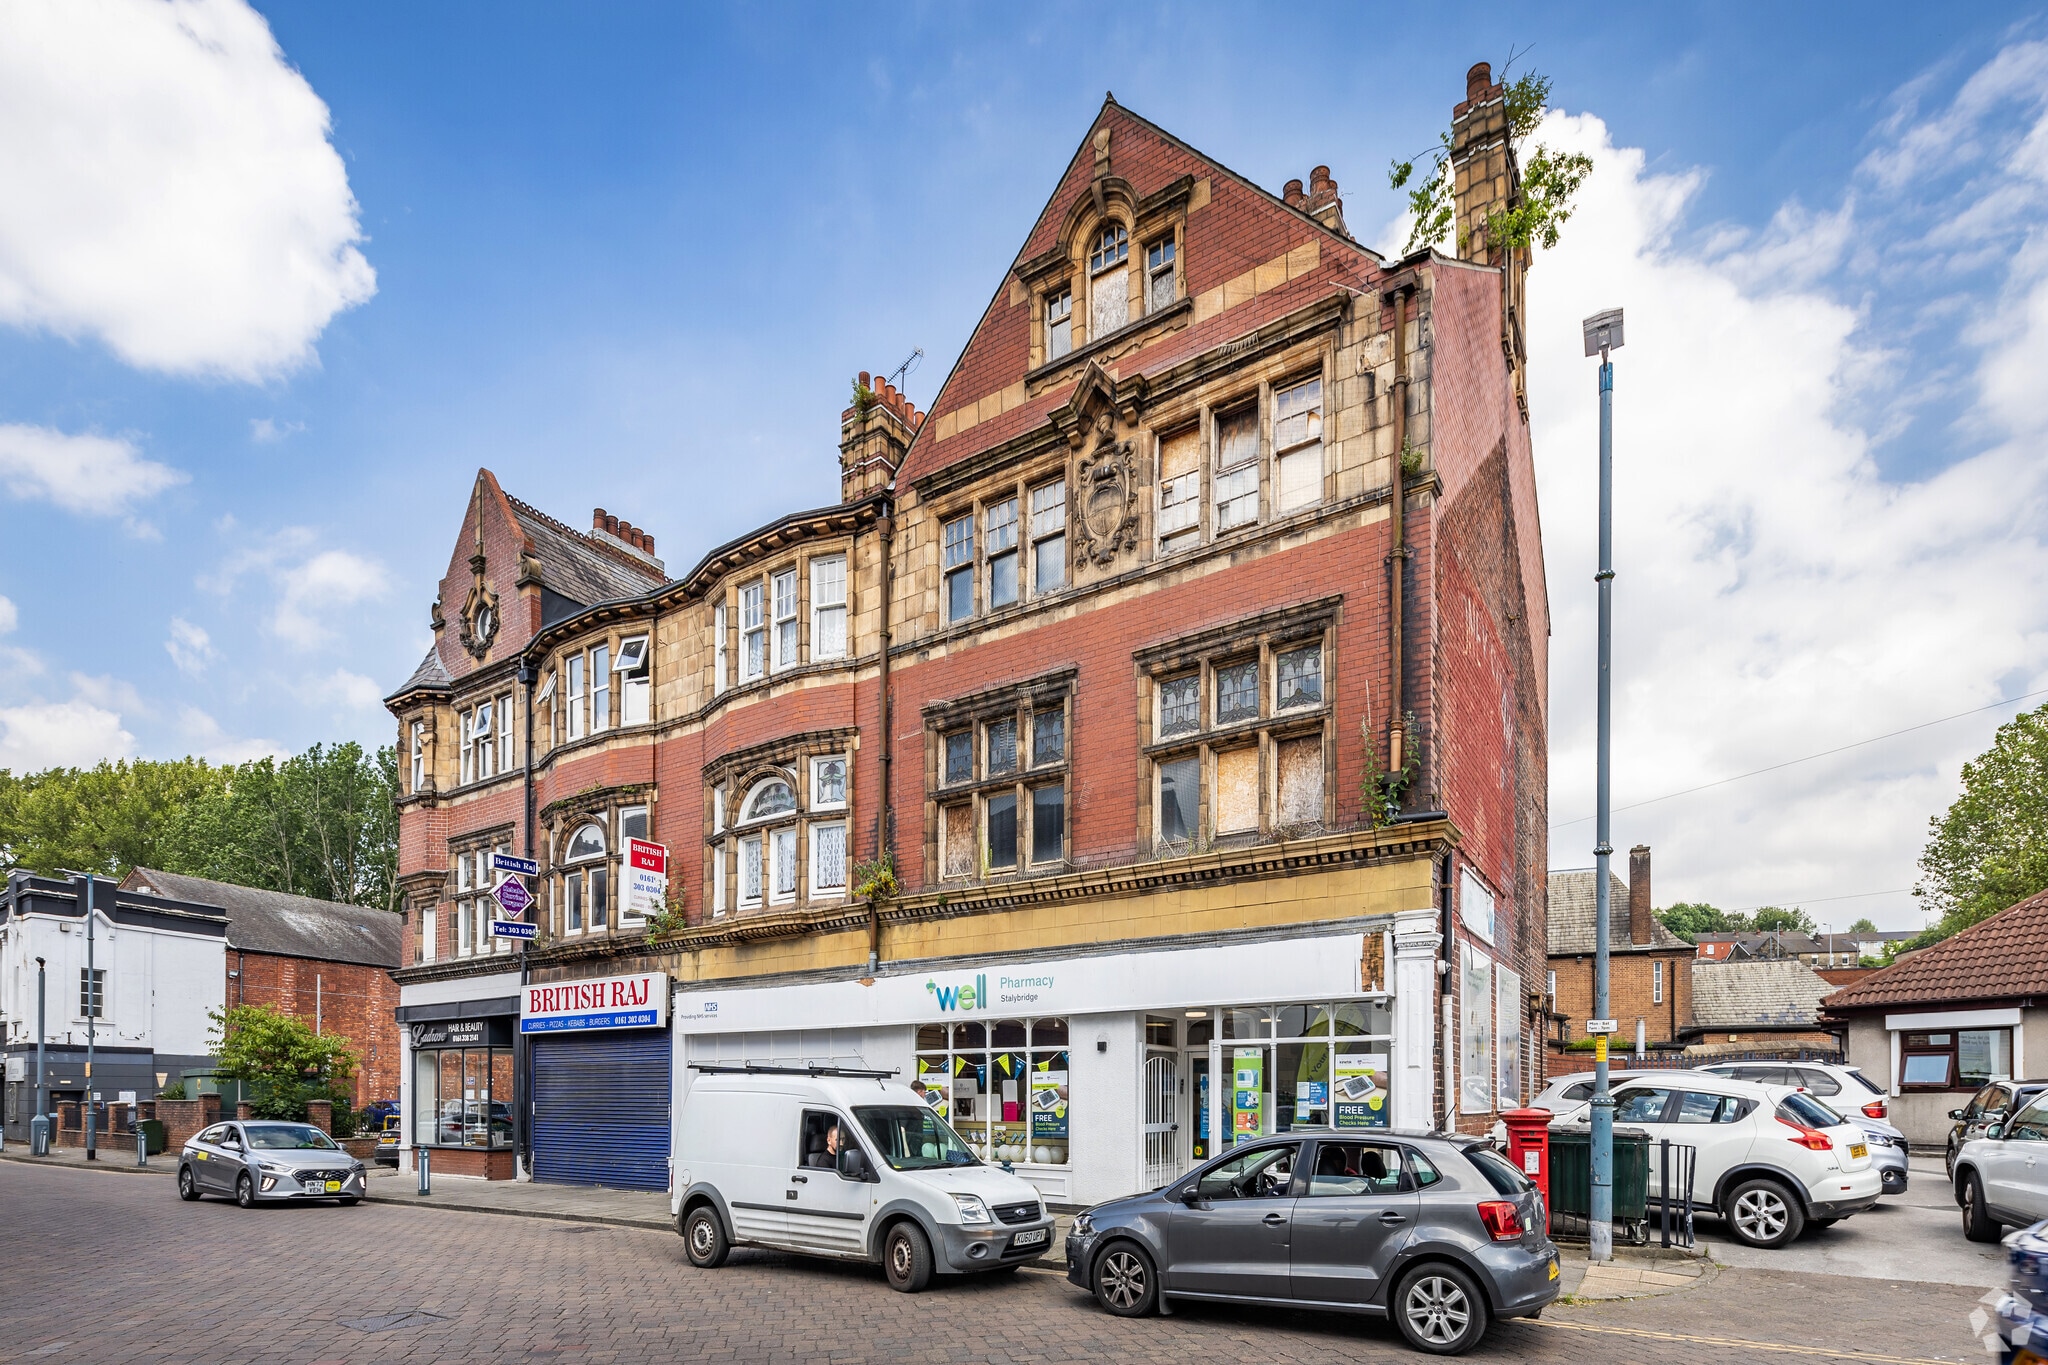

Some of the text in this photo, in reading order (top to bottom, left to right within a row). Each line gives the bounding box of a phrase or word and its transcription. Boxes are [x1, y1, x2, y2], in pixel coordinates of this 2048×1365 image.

[632, 844, 662, 858] BRITISH
[495, 857, 536, 872] British Raj
[641, 858, 655, 867] RAJ
[640, 874, 654, 883] 0161
[633, 883, 661, 894] 303 0304
[1000, 976, 1054, 989] Pharmacy
[529, 978, 650, 1013] BRITISH RAJ
[936, 973, 987, 1012] well
[1000, 993, 1038, 1003] Stalybridge
[705, 1002, 718, 1011] NHS
[528, 1020, 546, 1029] CURRIES
[549, 1019, 564, 1028] PIZZAS
[568, 1018, 586, 1027] KEBABS
[589, 1017, 610, 1026] BURGERS
[614, 1016, 626, 1025] 0161
[627, 1015, 637, 1024] 303
[638, 1014, 650, 1023] 0304
[448, 1022, 483, 1033] HAIR & BEAUTY
[1311, 1052, 1328, 1073] Your
[1339, 1106, 1364, 1114] FREE
[1035, 1114, 1052, 1122] FREE
[1016, 1233, 1032, 1244] KU60
